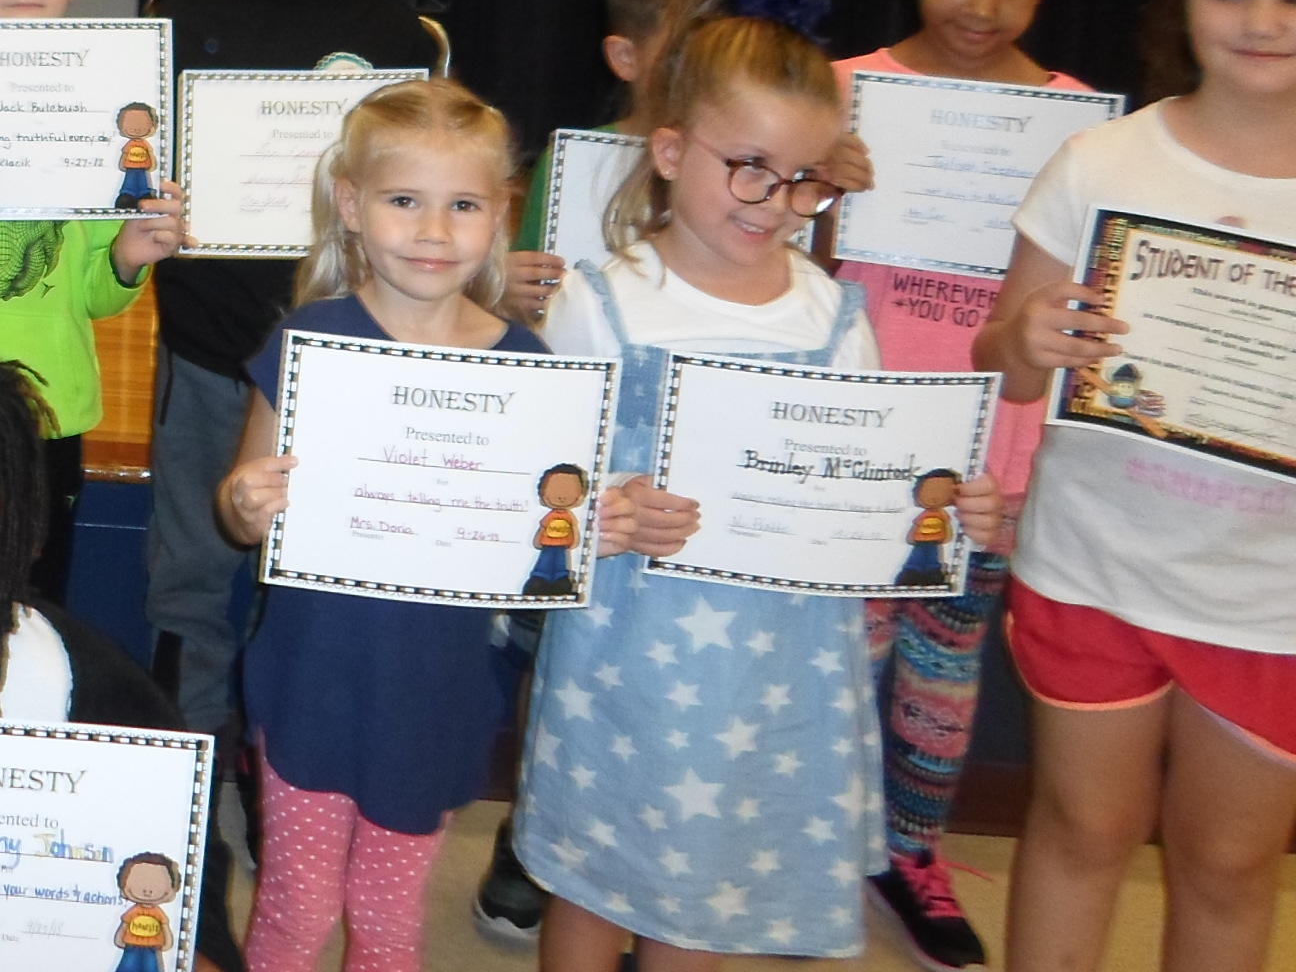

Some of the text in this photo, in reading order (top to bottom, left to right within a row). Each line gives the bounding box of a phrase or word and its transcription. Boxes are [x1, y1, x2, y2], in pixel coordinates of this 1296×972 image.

[10, 82, 75, 94] Presented to
[262, 98, 348, 115] HONESTY
[16, 131, 66, 143] truthful
[272, 128, 334, 140] Presented to
[1130, 239, 1225, 281] STUDENT
[1229, 263, 1257, 286] OF
[907, 297, 980, 328] YOU GO
[392, 385, 515, 415] HONESTY
[770, 401, 894, 428] HONESTY
[405, 426, 490, 447] Presented to
[383, 443, 484, 471] Violet Weber
[785, 438, 868, 457] Presented to
[407, 489, 442, 513] telling
[474, 495, 492, 510] the
[42, 815, 59, 830] to
[31, 827, 114, 863] Johnson
[2, 882, 29, 902] your
[34, 883, 71, 901] words
[1, 933, 22, 944] Date
